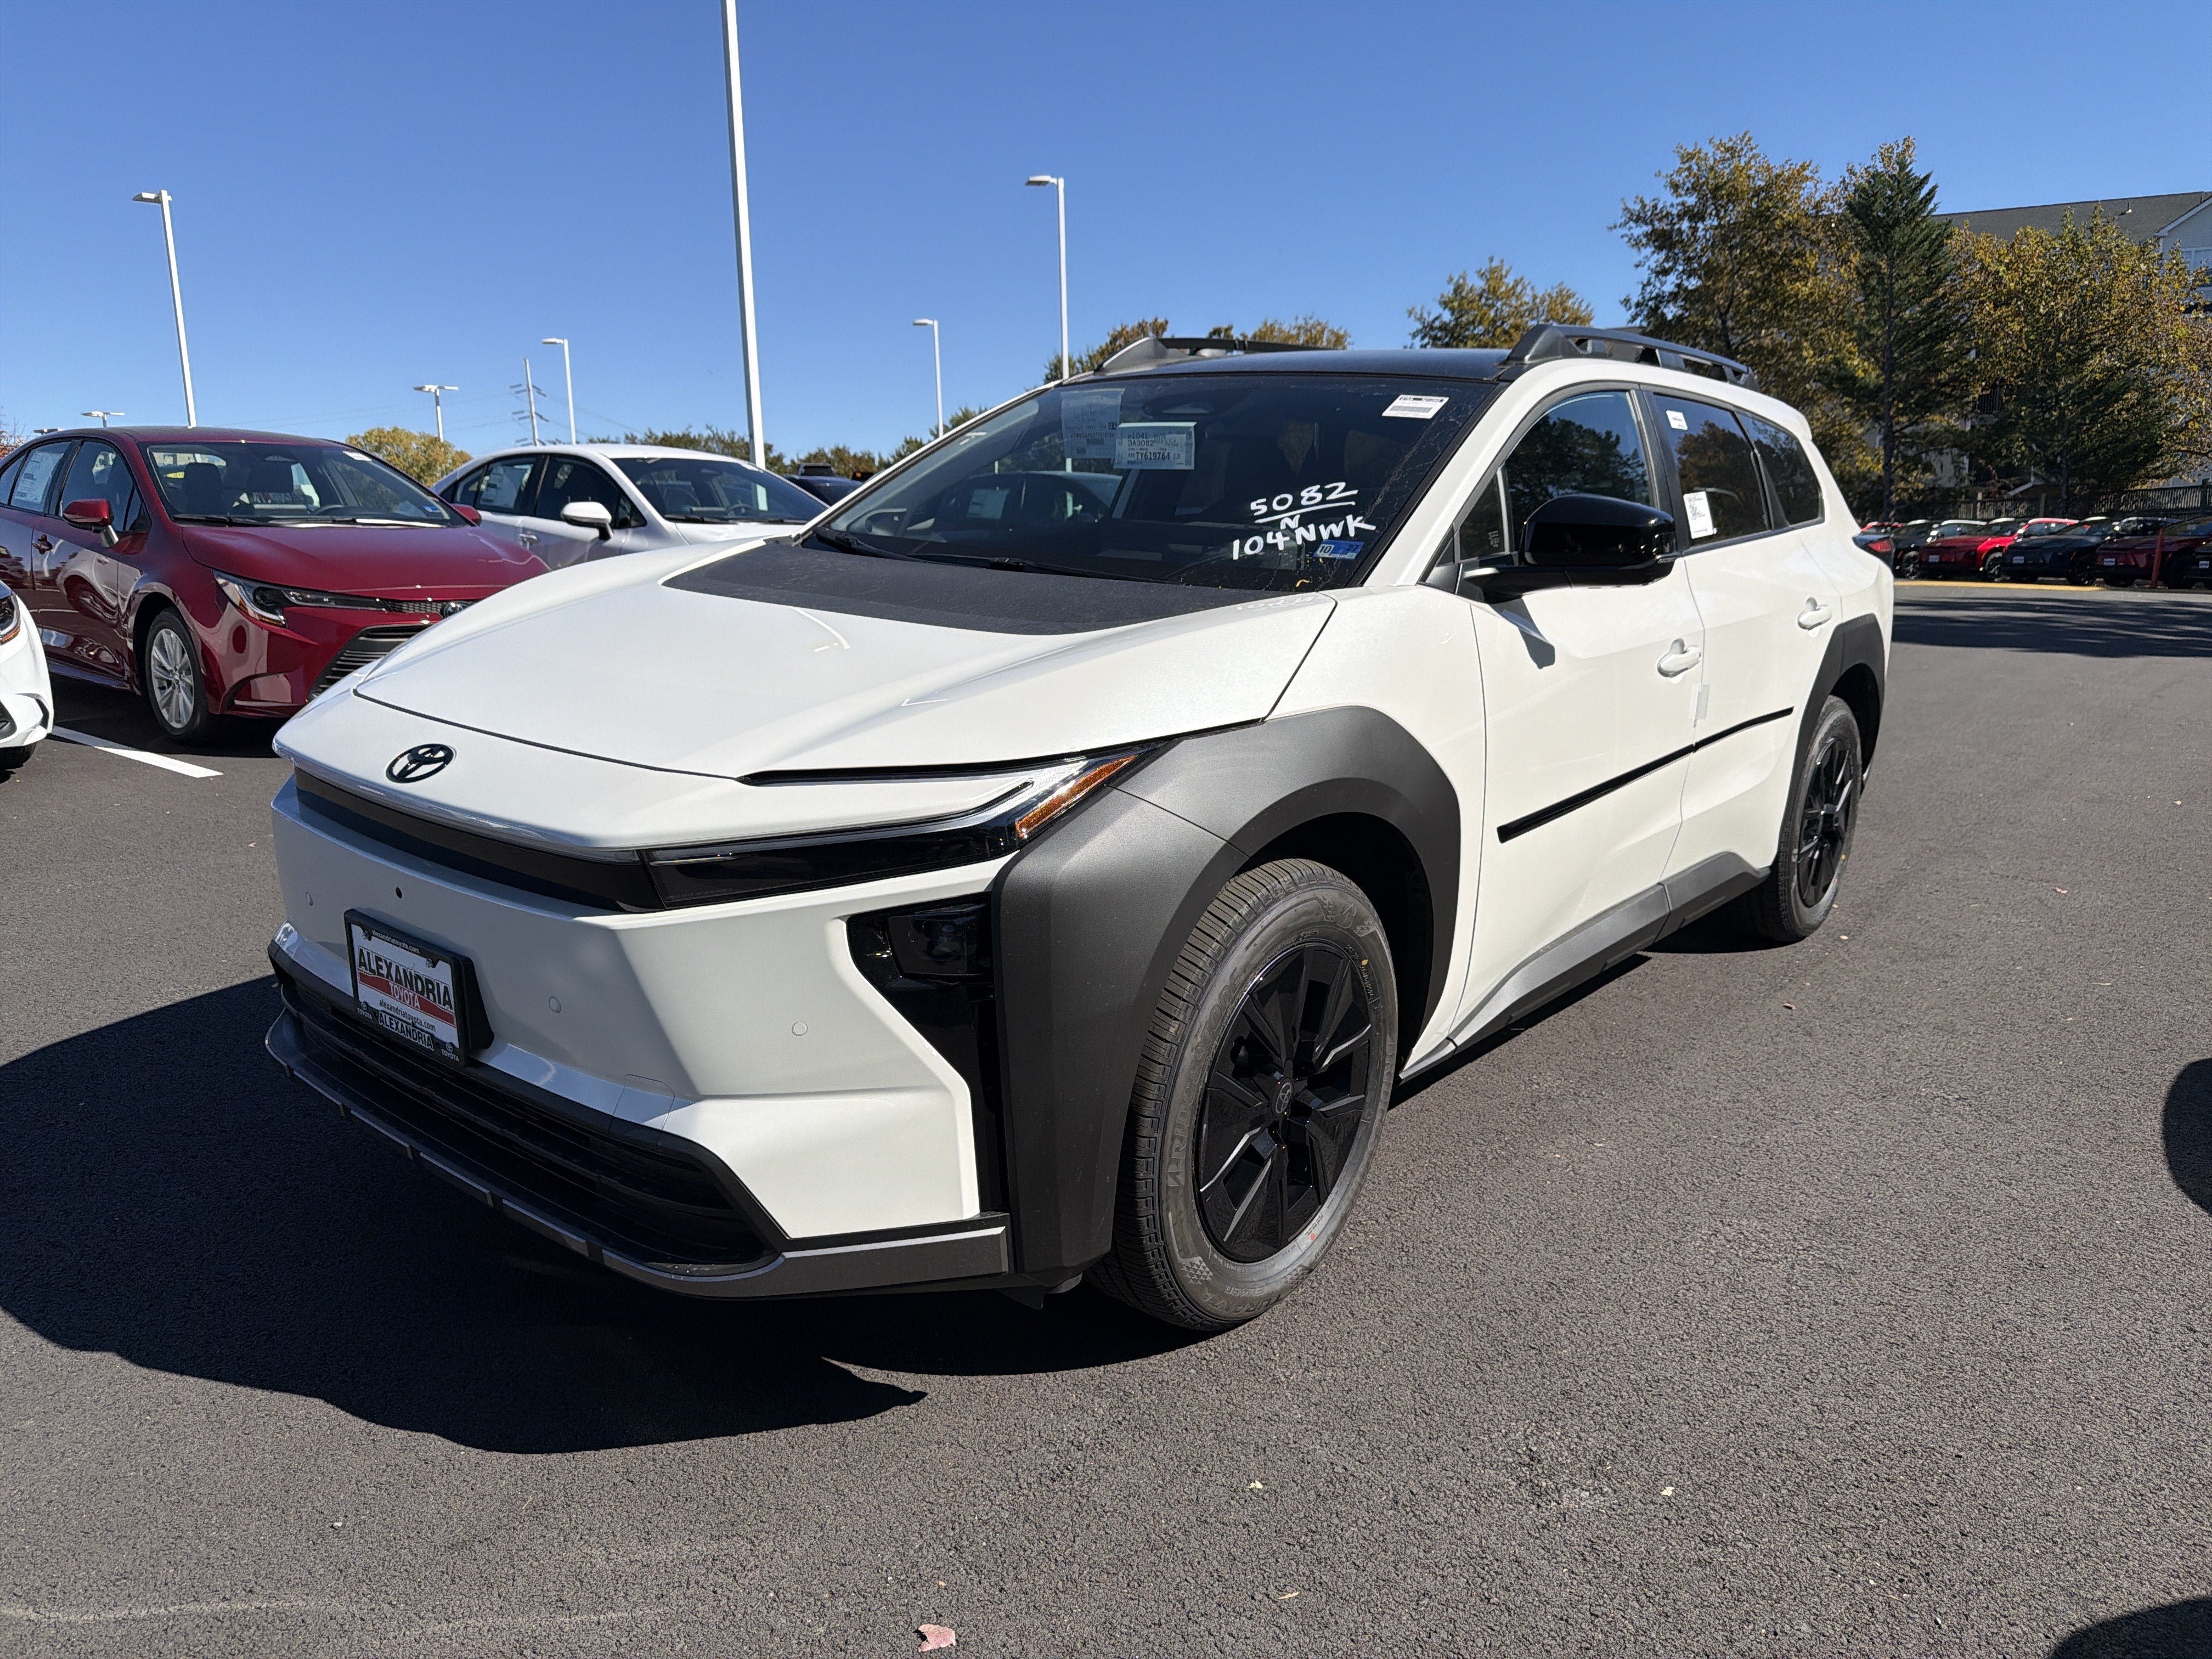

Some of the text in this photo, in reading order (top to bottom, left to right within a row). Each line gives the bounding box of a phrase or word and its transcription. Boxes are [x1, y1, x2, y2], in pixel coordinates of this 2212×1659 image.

[1136, 451, 1170, 461] TY619764
[1250, 482, 1359, 516] 5082
[1319, 545, 1332, 554] 10
[358, 947, 453, 1011] ALEXANDRIA
[389, 982, 421, 1009] TOYOTA
[357, 1007, 373, 1020] TOYOTA
[379, 998, 436, 1033] alexandriatoyota.com
[378, 1011, 435, 1052] ALEXANDRIA
[441, 1048, 460, 1063] TOYOTA
